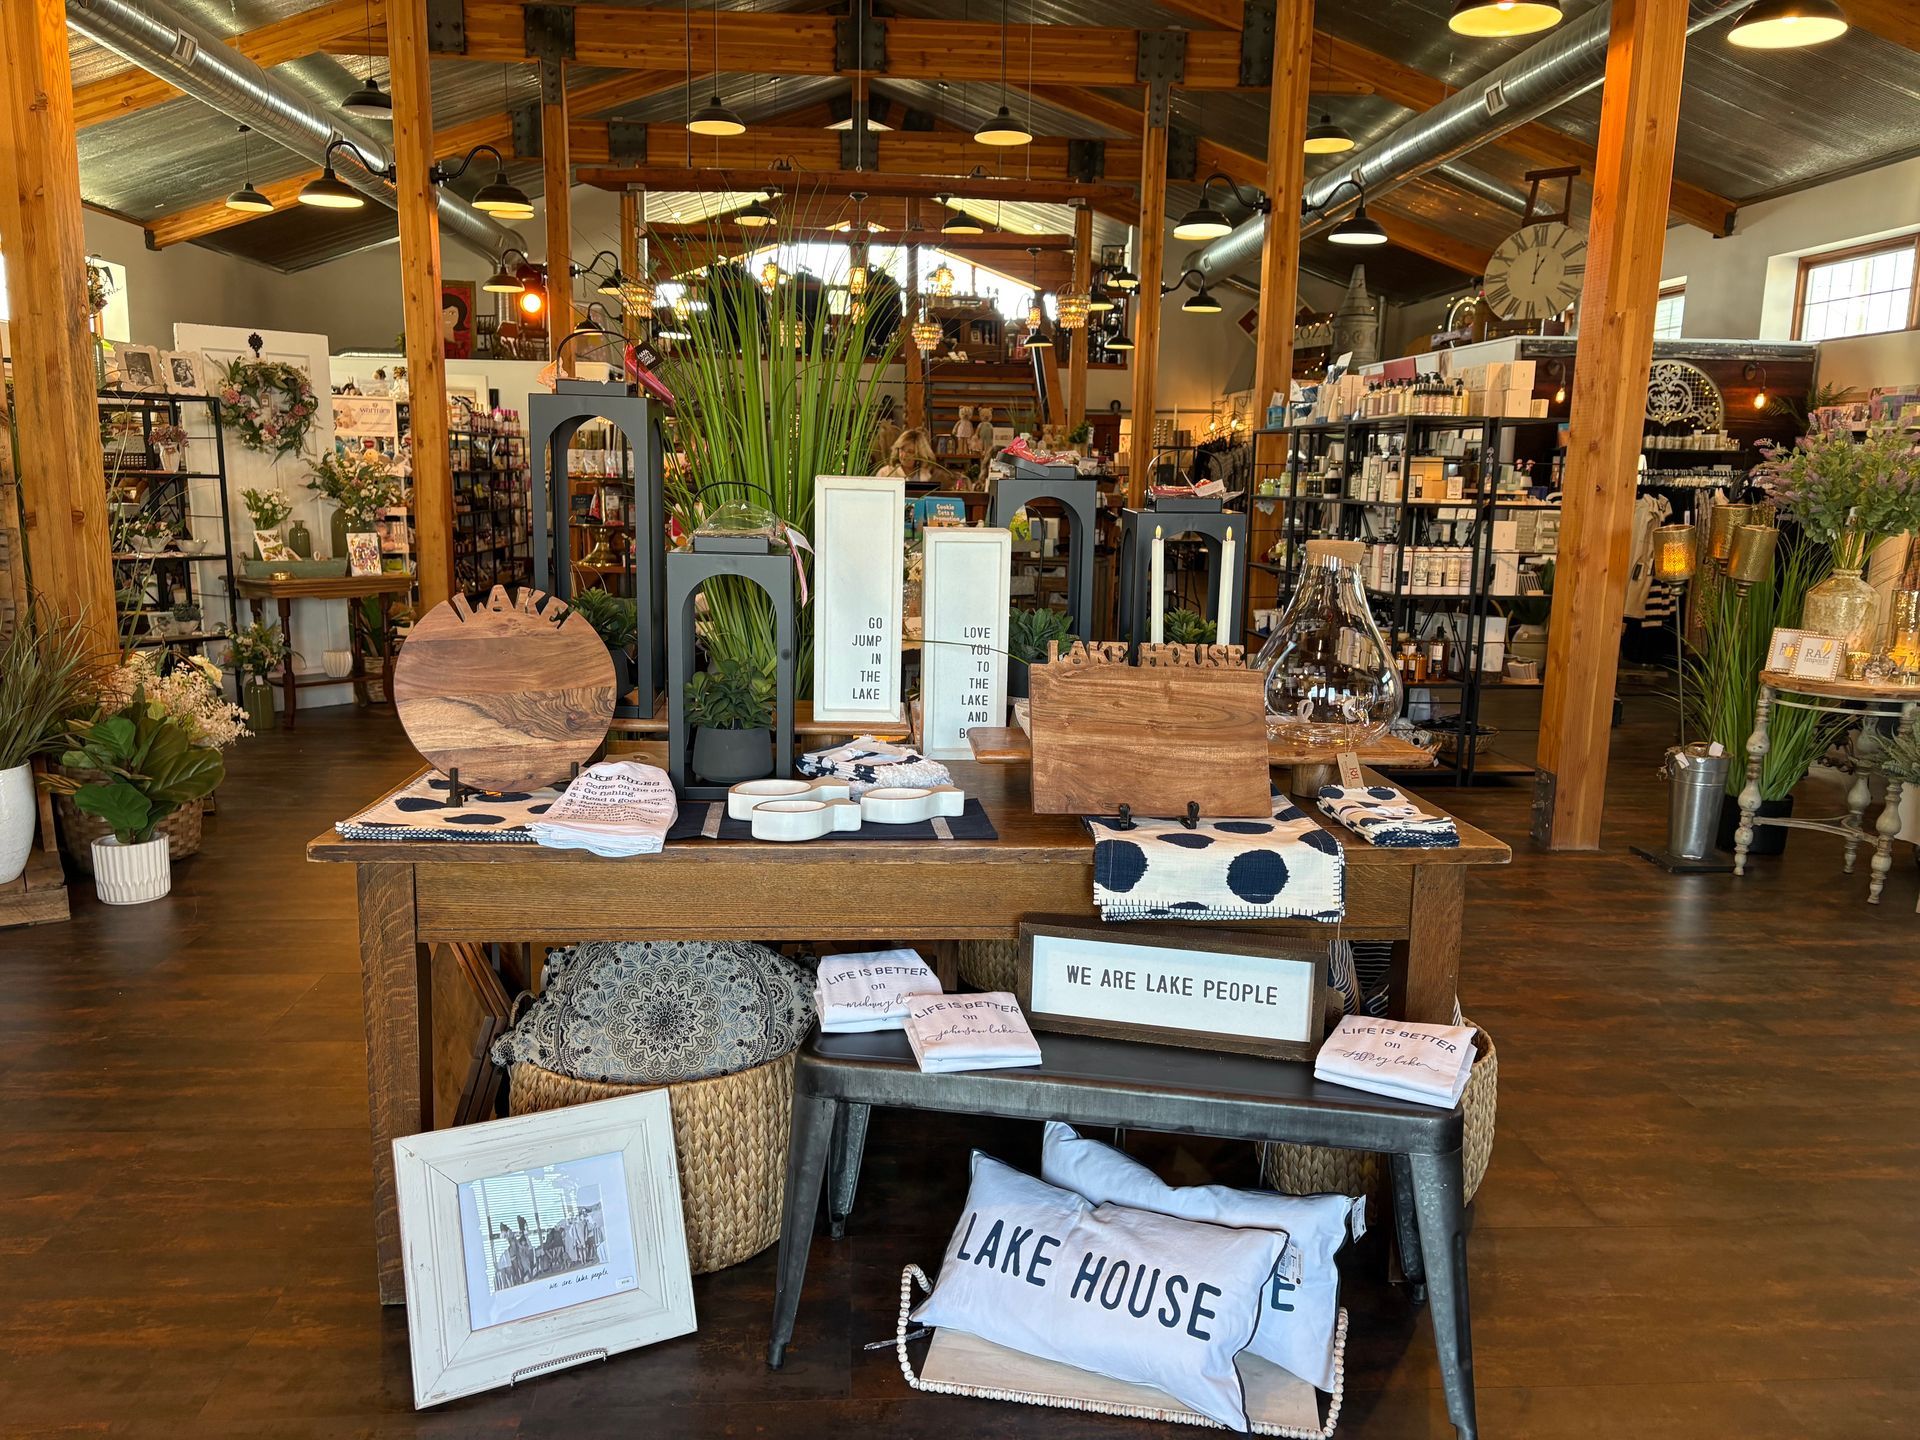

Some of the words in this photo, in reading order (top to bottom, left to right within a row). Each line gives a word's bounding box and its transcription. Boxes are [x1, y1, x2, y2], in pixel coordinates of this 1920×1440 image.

[935, 503, 955, 511] Cookie
[452, 584, 568, 629] LAKE
[868, 617, 883, 629] GO
[964, 627, 991, 639] LOVE
[851, 635, 883, 648] JUMP
[970, 644, 991, 656] YOU
[1047, 639, 1129, 667] LAKE
[1137, 641, 1247, 669] HOUSE
[870, 653, 882, 665] IN
[977, 661, 990, 673] TO
[860, 670, 881, 682] THE
[969, 677, 989, 690] THE
[852, 688, 880, 700] LAKE
[961, 694, 989, 706] LAKE
[967, 711, 988, 723] AND
[586, 782, 616, 790] Coffee
[615, 775, 660, 786] RULES
[584, 787, 597, 795] Go
[826, 971, 856, 985] LIFE
[859, 968, 872, 977] IS
[874, 966, 928, 976] BETTER
[871, 982, 886, 991] on
[1066, 964, 1092, 986] WE
[1100, 969, 1136, 990] ARE
[1146, 973, 1193, 997] LAKE
[1203, 979, 1278, 1006] PEOPLE
[914, 1003, 946, 1019] LIFE
[947, 1001, 963, 1009] IS
[964, 1001, 1020, 1015] BETTER
[962, 1013, 978, 1021] on
[1342, 1027, 1376, 1036] LIFE
[1381, 1027, 1396, 1035] IS
[1399, 1031, 1457, 1054] BETTER
[1384, 1041, 1401, 1049] on
[549, 1282, 558, 1290] we
[591, 1268, 609, 1281] people
[956, 1212, 1062, 1288] LAKE
[1070, 1251, 1223, 1342] HOUSE
